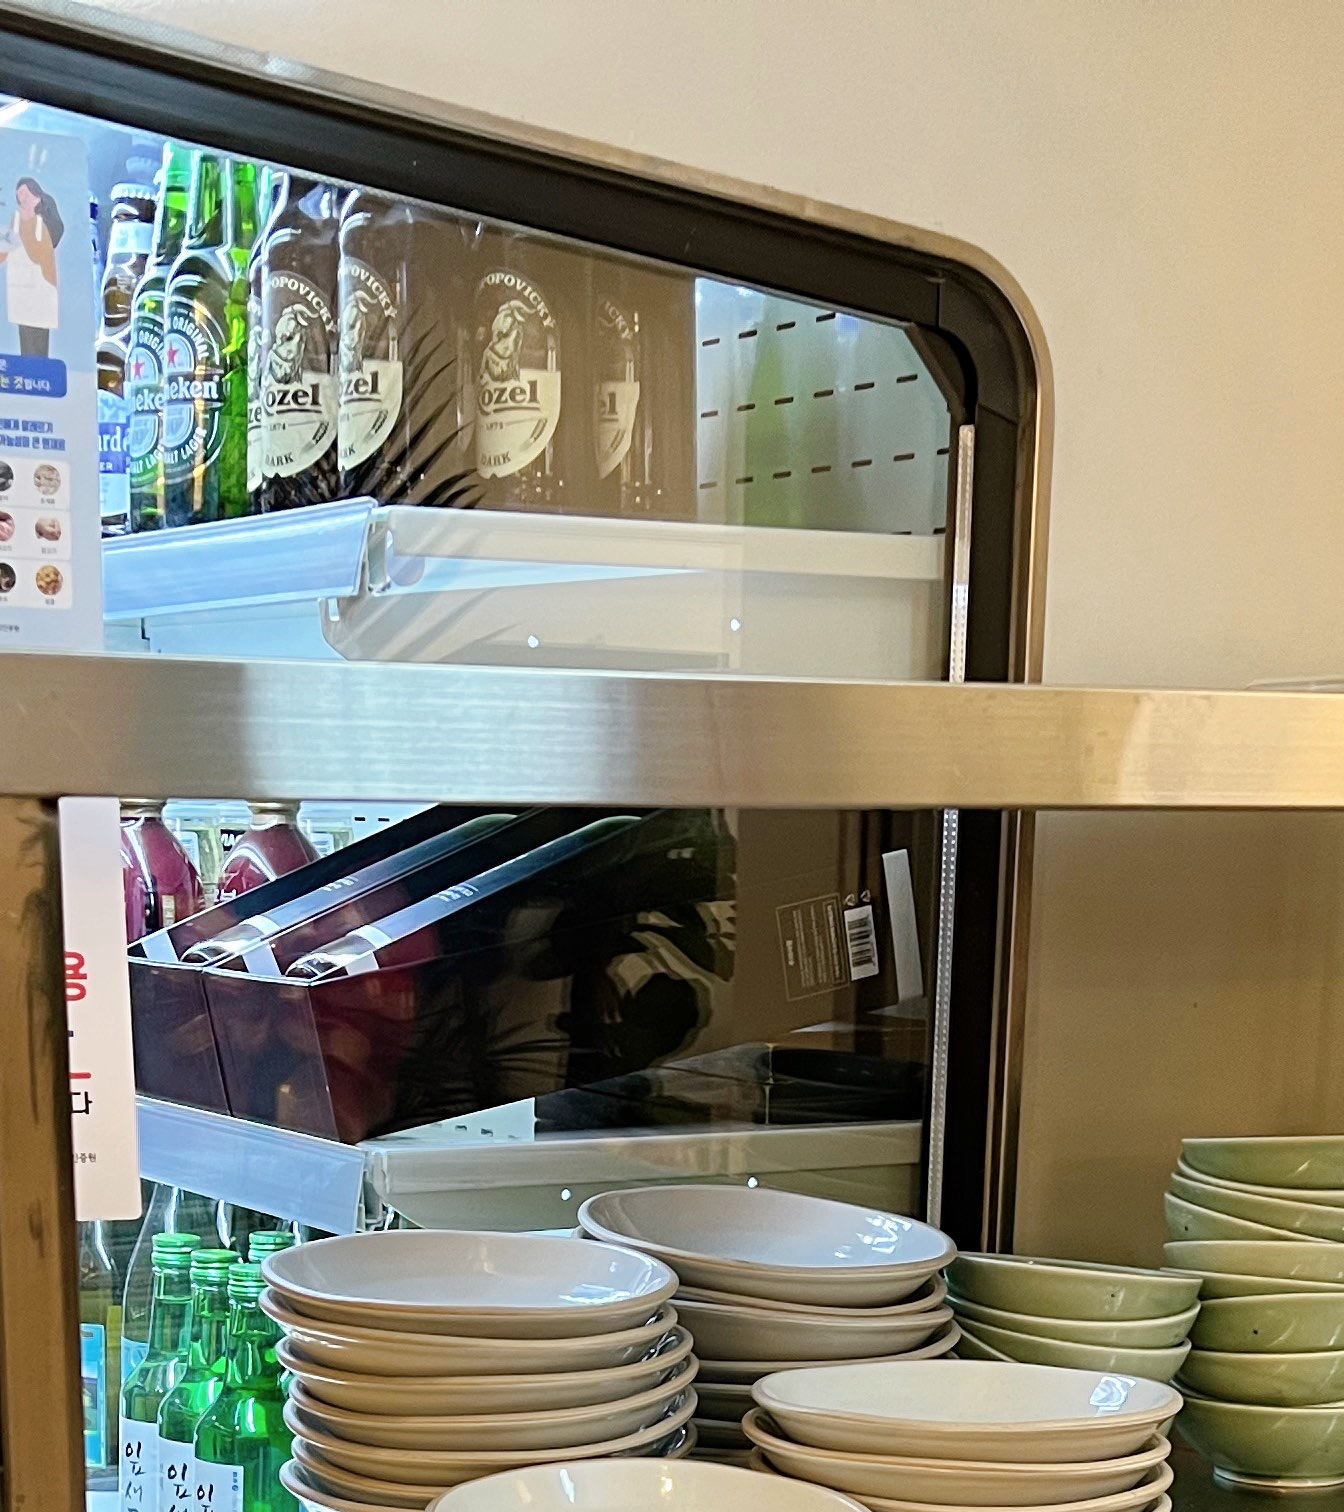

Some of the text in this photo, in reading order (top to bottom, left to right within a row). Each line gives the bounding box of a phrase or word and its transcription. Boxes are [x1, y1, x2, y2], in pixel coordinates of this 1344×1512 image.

[139, 331, 164, 353] ORIGI
[169, 376, 219, 400] eken
[344, 370, 381, 396] zel
[481, 380, 540, 406] ozel
[265, 384, 322, 407] ozel
